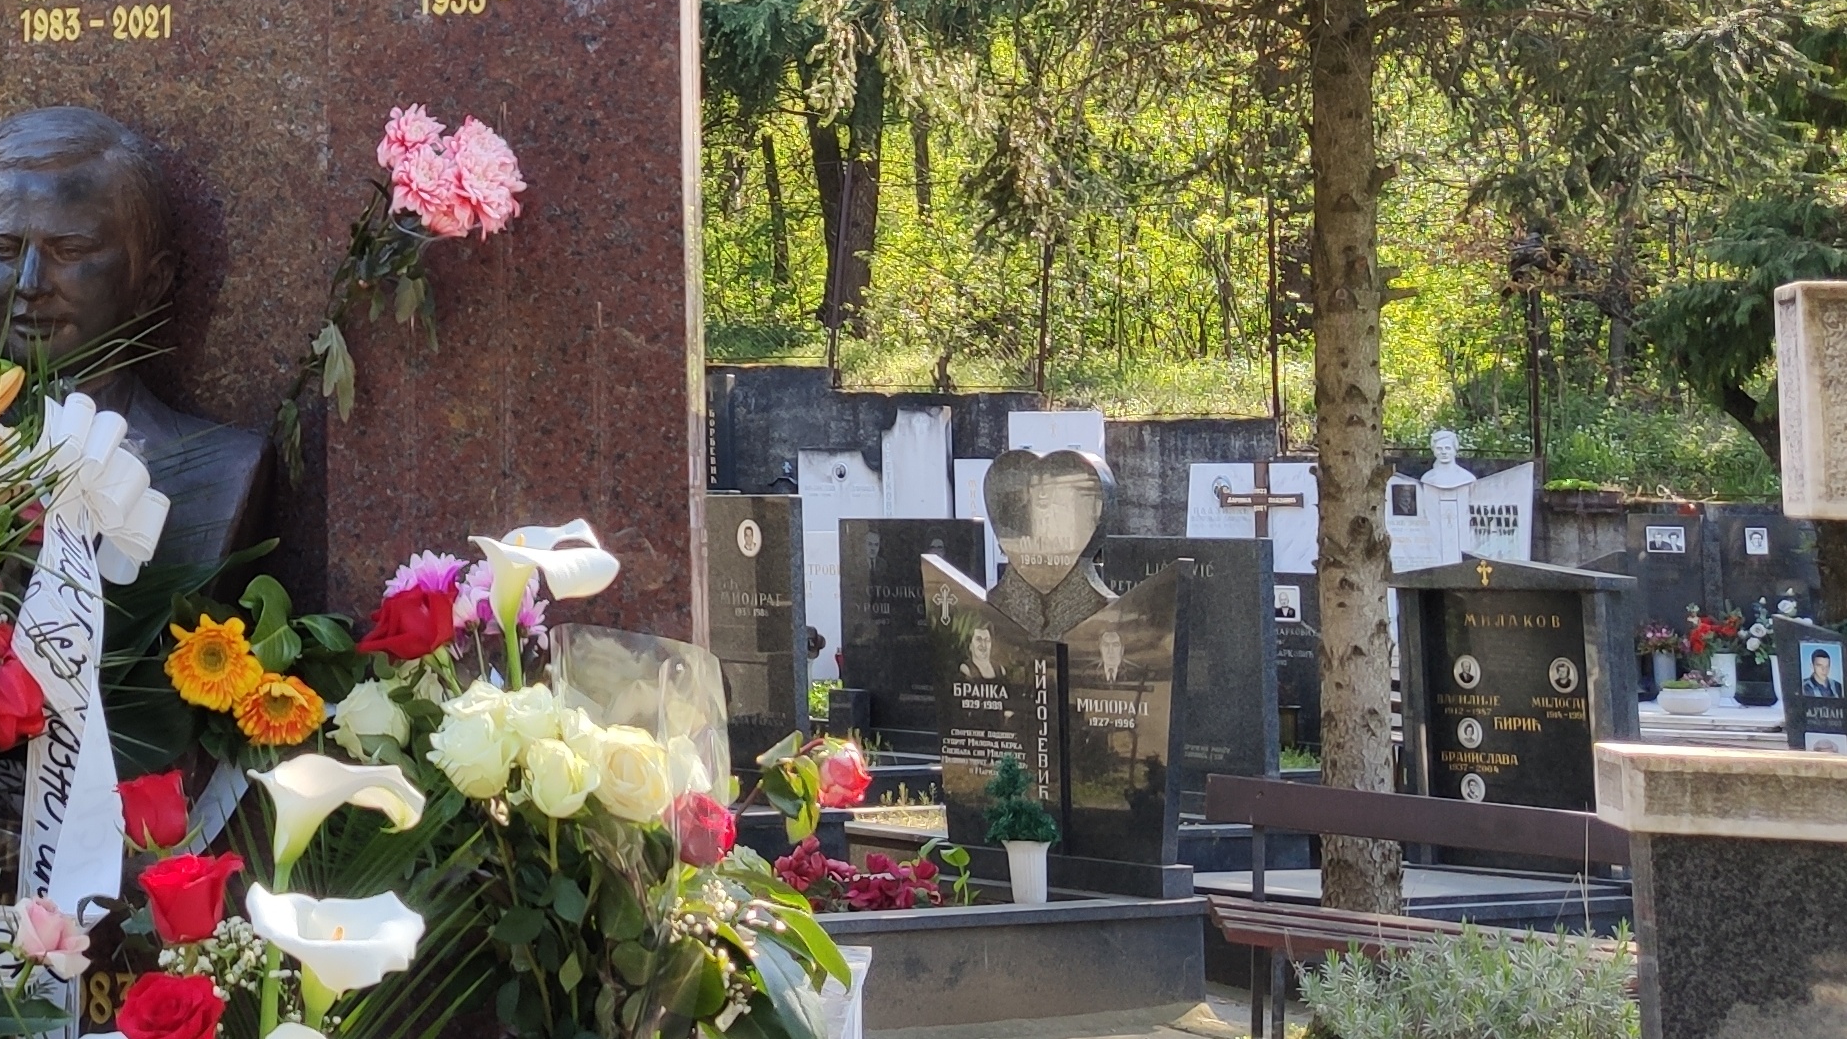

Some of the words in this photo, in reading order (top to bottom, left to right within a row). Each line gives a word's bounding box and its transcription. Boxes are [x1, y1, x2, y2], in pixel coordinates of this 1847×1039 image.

[1463, 612, 1562, 629] МИЛАКОВ
[952, 682, 1009, 700] БРАНКА
[1075, 697, 1150, 717] МИЛОРАД
[1034, 658, 1050, 801] МИЛОЈЕВИЋ
[1493, 715, 1542, 733] ЋИРИЋ
[1441, 750, 1519, 766] БРАНИСЛАВА
